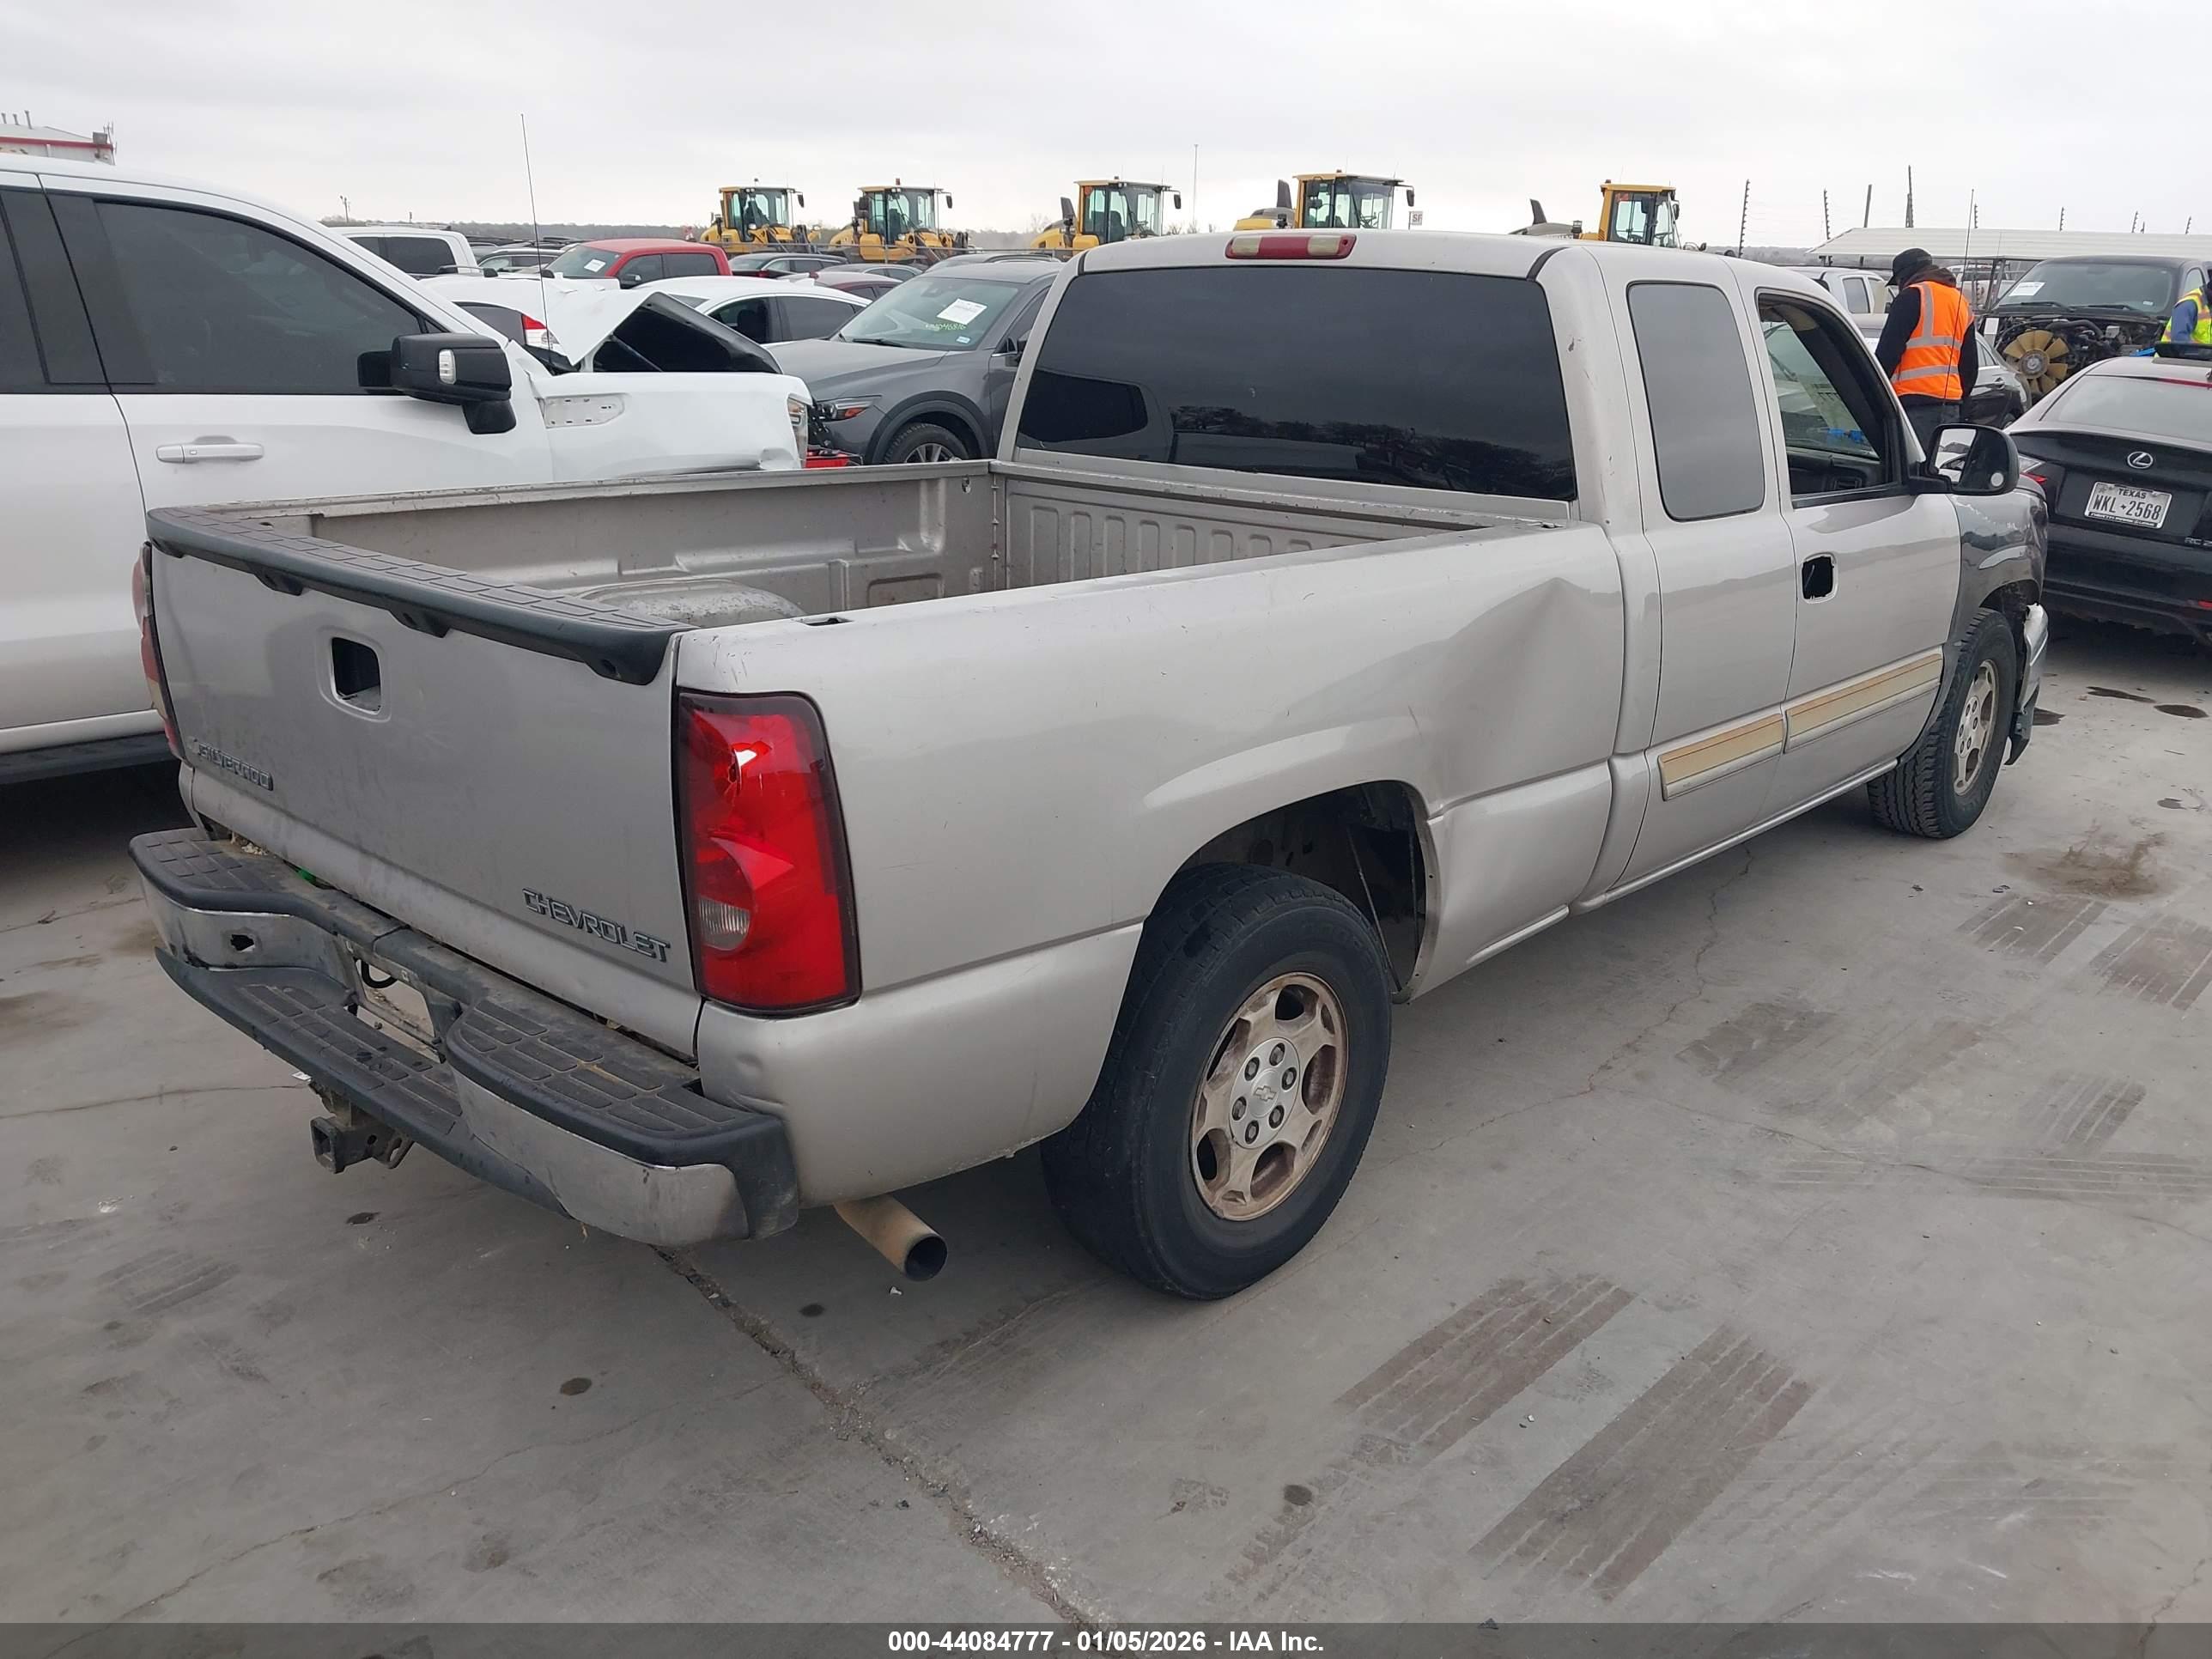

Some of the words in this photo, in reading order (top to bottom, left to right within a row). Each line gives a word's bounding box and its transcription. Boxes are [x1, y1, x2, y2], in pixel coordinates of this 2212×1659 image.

[2093, 494, 2117, 514] WKL
[2125, 500, 2162, 520] 2568
[2118, 488, 2147, 500] TEXAS
[522, 888, 671, 963] CHEVROLET
